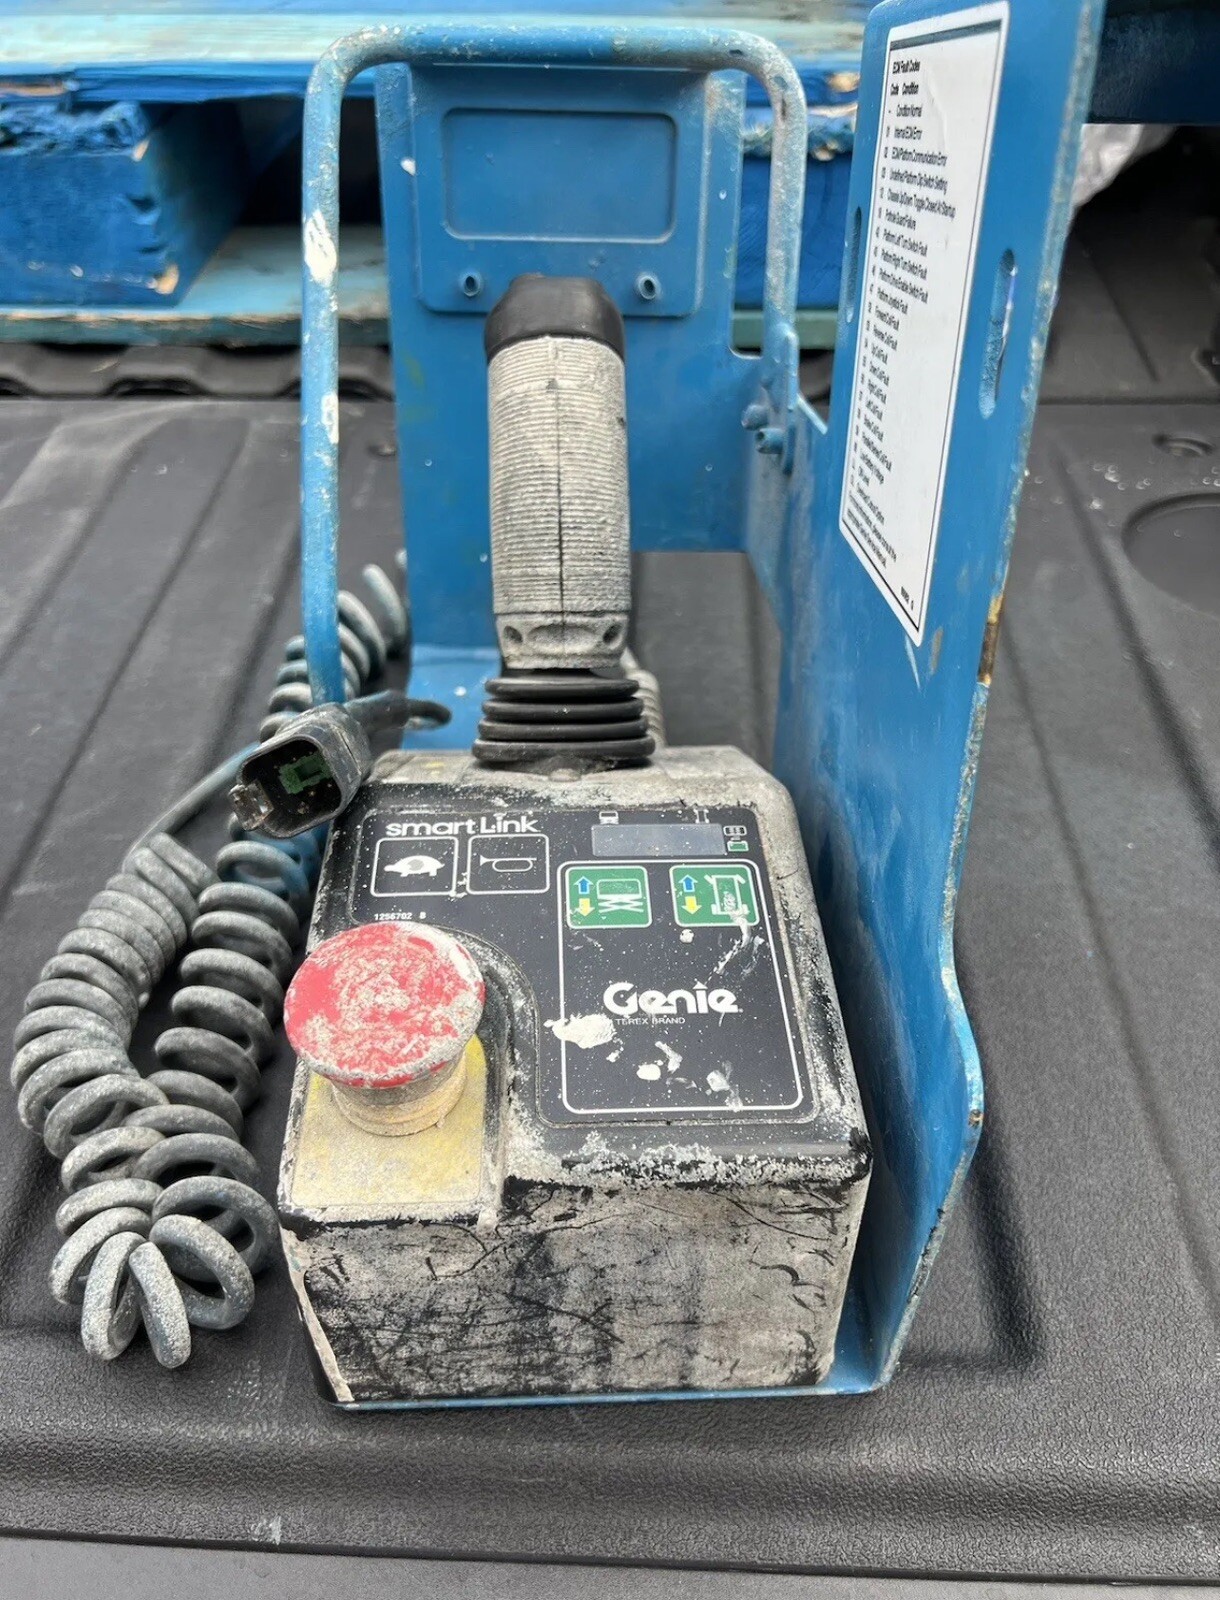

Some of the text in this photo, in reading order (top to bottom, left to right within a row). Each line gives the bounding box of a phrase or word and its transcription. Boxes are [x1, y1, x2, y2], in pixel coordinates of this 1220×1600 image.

[603, 981, 739, 1016] Genie
[615, 1016, 686, 1026] TEREX BRAND
